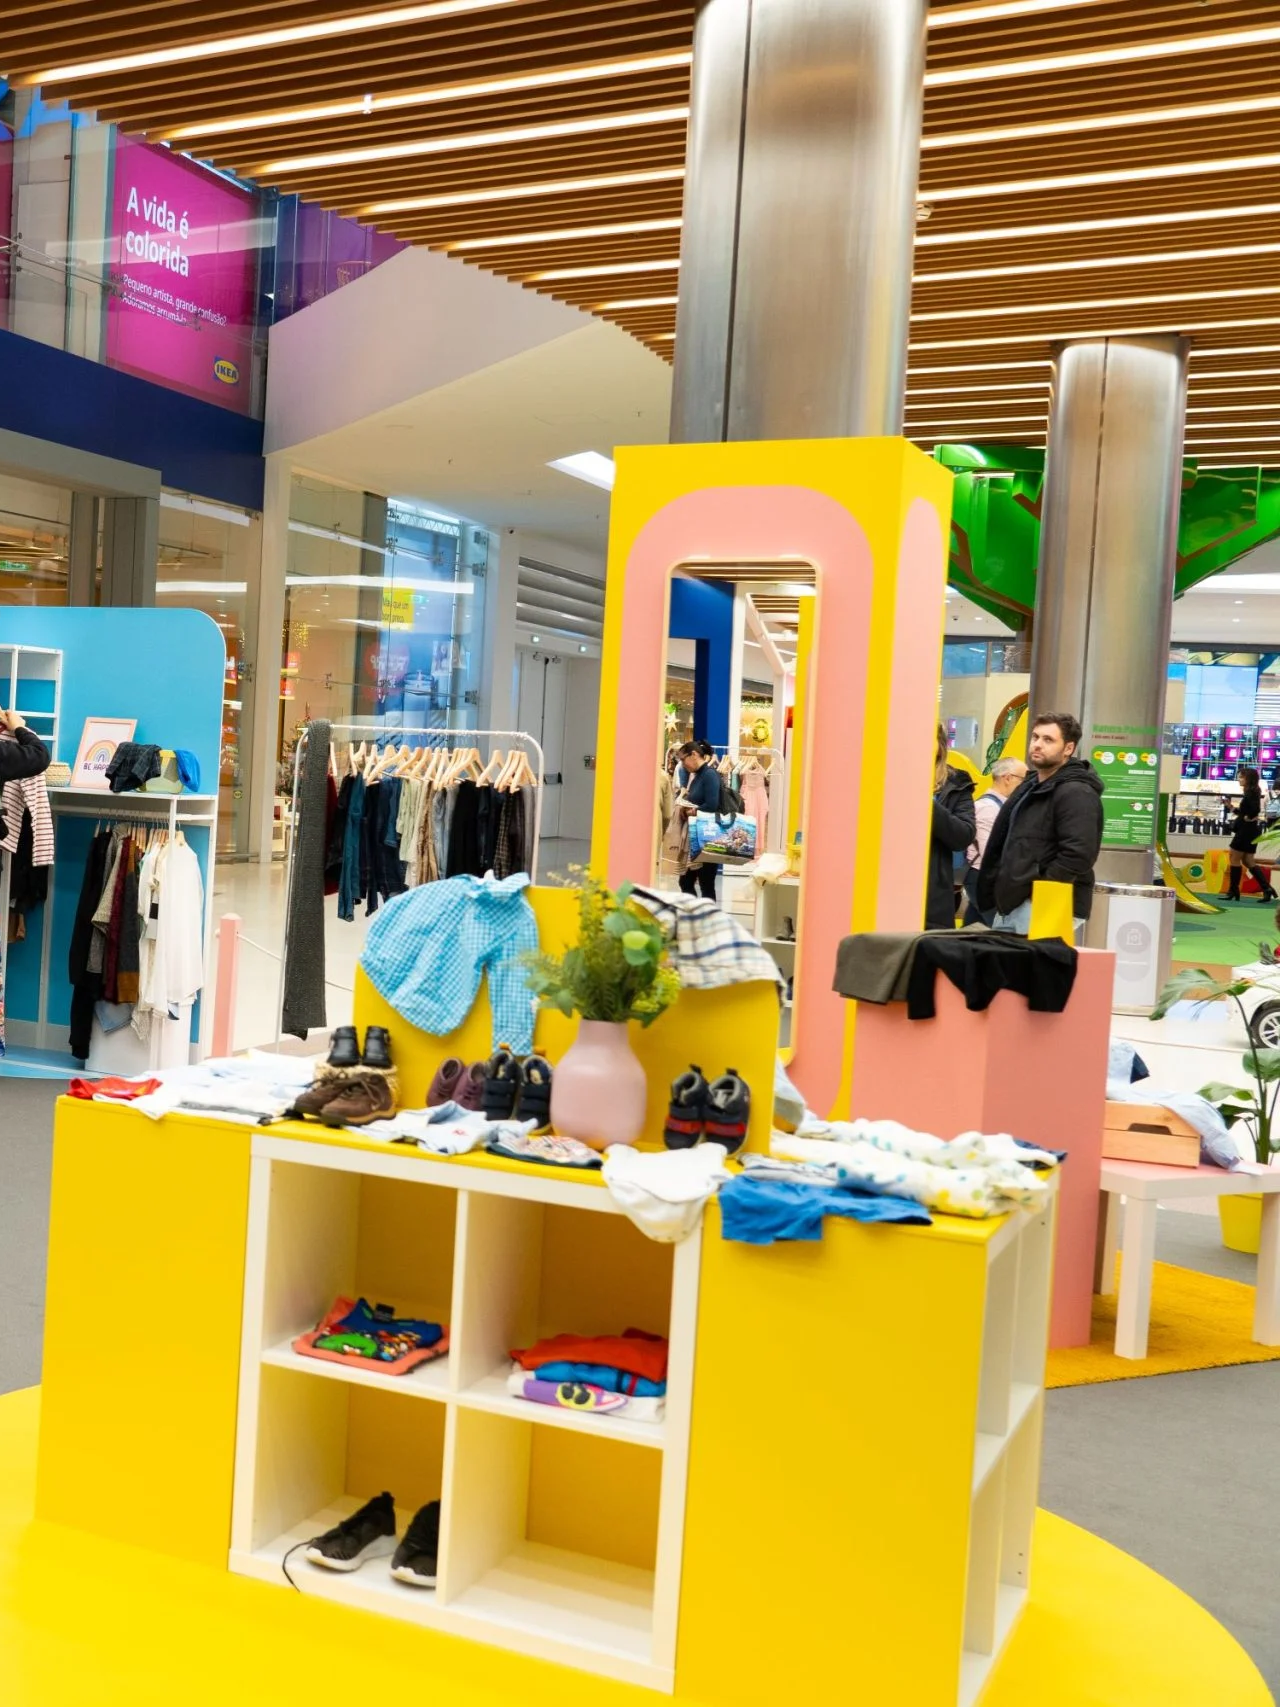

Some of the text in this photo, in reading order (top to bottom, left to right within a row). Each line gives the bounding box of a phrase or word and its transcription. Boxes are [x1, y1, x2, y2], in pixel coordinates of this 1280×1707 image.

[126, 186, 190, 240] A vida é
[125, 229, 190, 278] colorida
[122, 273, 152, 296] Pequeno
